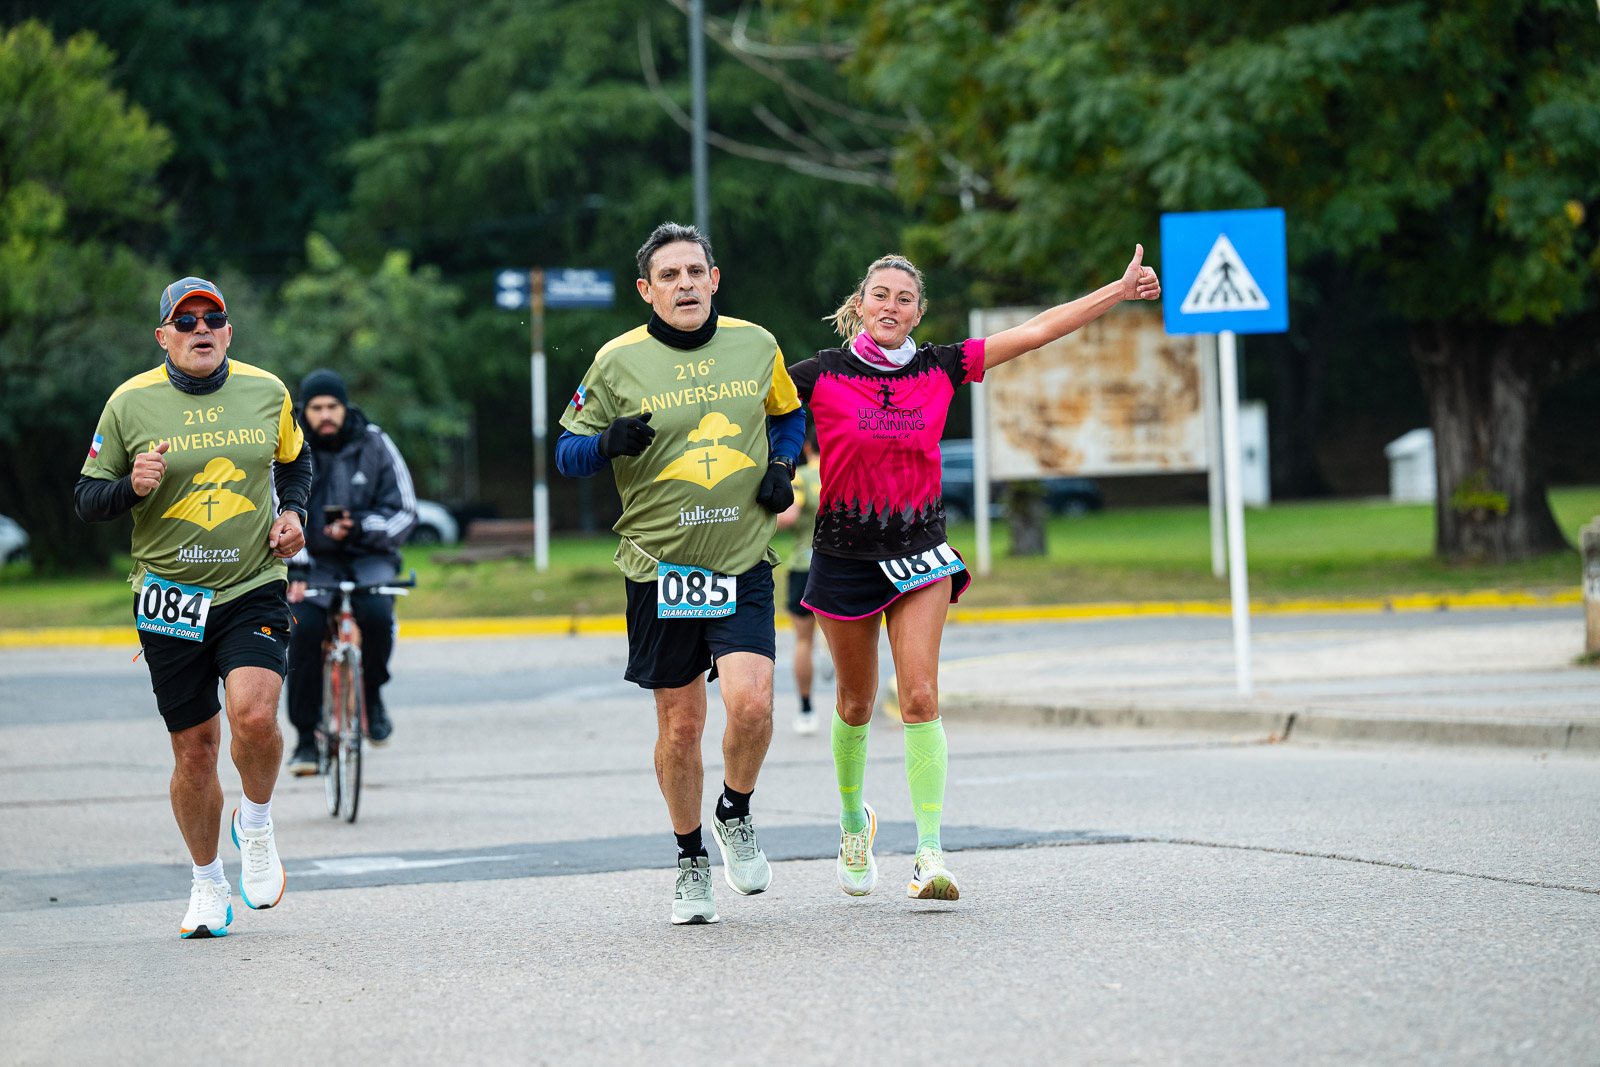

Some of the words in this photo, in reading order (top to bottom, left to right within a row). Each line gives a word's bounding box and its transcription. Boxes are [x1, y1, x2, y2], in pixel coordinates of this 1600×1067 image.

[674, 358, 716, 380] 216°
[641, 380, 759, 415] ANIVERSARIO
[183, 406, 224, 425] 216°
[858, 408, 923, 419] WOMAN
[858, 420, 926, 431] RUNNING
[148, 428, 266, 453] ANIVERSARIO
[678, 505, 740, 527] julicroc
[175, 544, 240, 562] julicroc
[662, 570, 729, 607] 085
[902, 573, 937, 591] DIAMANTE
[937, 564, 961, 577] CORRE
[143, 582, 205, 629] 084
[661, 609, 704, 617] DIAMANTE
[705, 607, 733, 616] CORRE
[140, 622, 175, 635] DIAMANTE
[175, 629, 201, 639] CORRE
